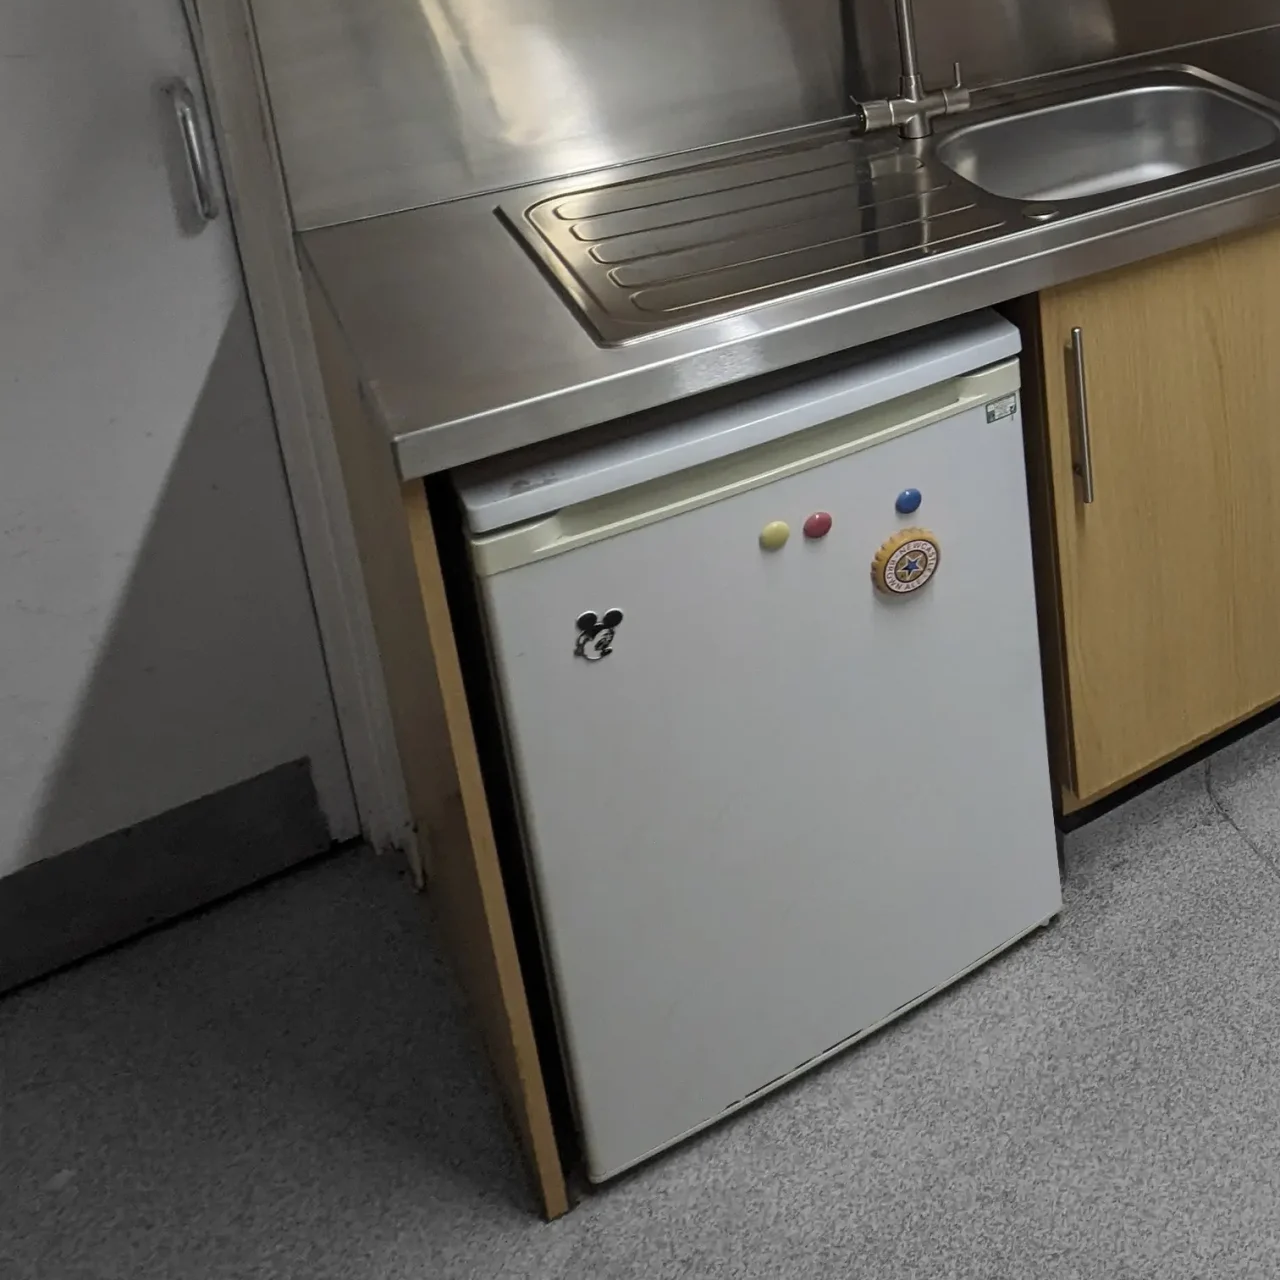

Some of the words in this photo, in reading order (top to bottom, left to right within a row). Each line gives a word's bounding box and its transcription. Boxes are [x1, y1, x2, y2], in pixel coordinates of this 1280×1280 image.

[899, 541, 937, 573] NEWCASTLE
[887, 559, 902, 590] BROWN
[904, 578, 922, 590] ALE
